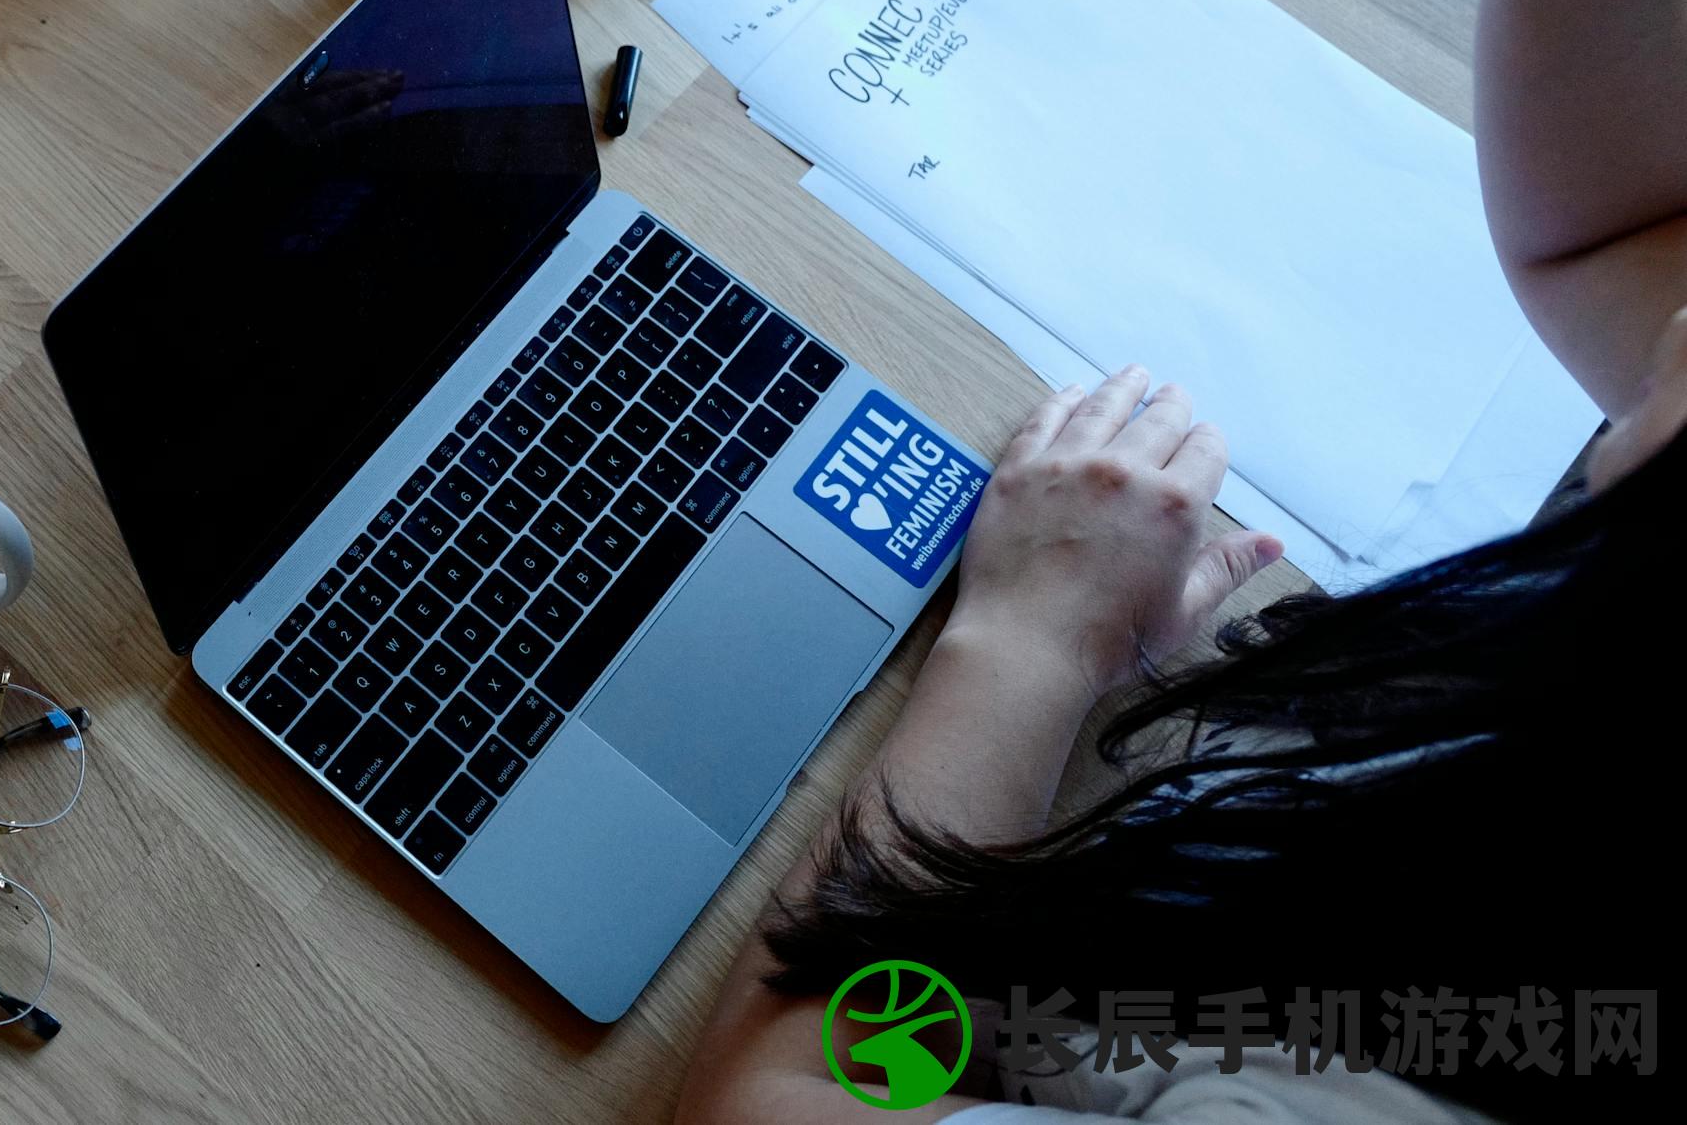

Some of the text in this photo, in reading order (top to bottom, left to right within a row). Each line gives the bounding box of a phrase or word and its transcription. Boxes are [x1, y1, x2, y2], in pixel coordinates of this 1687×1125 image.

[920, 29, 969, 78] SERIES
[907, 154, 942, 180] TAR
[617, 369, 627, 381] P
[545, 392, 557, 403] 9
[590, 401, 602, 412] O
[517, 425, 529, 436] 8
[635, 425, 648, 434] L
[488, 457, 499, 468] 7
[607, 455, 621, 468] K
[812, 407, 909, 512] STILL
[534, 465, 547, 478] U
[737, 461, 758, 483] option
[460, 491, 472, 502] 6
[582, 489, 592, 500] J
[506, 499, 518, 511] Y
[631, 501, 647, 516] M
[704, 491, 732, 525] command
[884, 457, 972, 560] FEMINISM
[551, 522, 565, 535] H
[910, 475, 984, 572] weiberwirtschaft.de
[430, 525, 443, 536] 5
[476, 533, 489, 545] T
[604, 535, 618, 549] N
[402, 559, 413, 570] 4
[523, 557, 536, 569] G
[447, 569, 461, 581] R
[576, 572, 589, 584] B
[370, 595, 382, 606] 3
[494, 592, 504, 604] F
[417, 603, 430, 616] E
[546, 606, 559, 618] V
[340, 630, 353, 642] 2
[463, 628, 477, 641] D
[385, 637, 400, 652] W
[518, 642, 531, 655] C
[309, 667, 320, 676] 1
[434, 663, 447, 676] S
[356, 676, 371, 688] Q
[487, 678, 501, 692] X
[404, 701, 417, 714] A
[458, 714, 472, 728] Z
[526, 710, 557, 748] command
[313, 742, 328, 757] tab
[354, 757, 384, 791] caps lock
[496, 758, 519, 784] option
[394, 806, 411, 827] shift
[464, 795, 488, 825] control
[432, 851, 445, 864] fn
